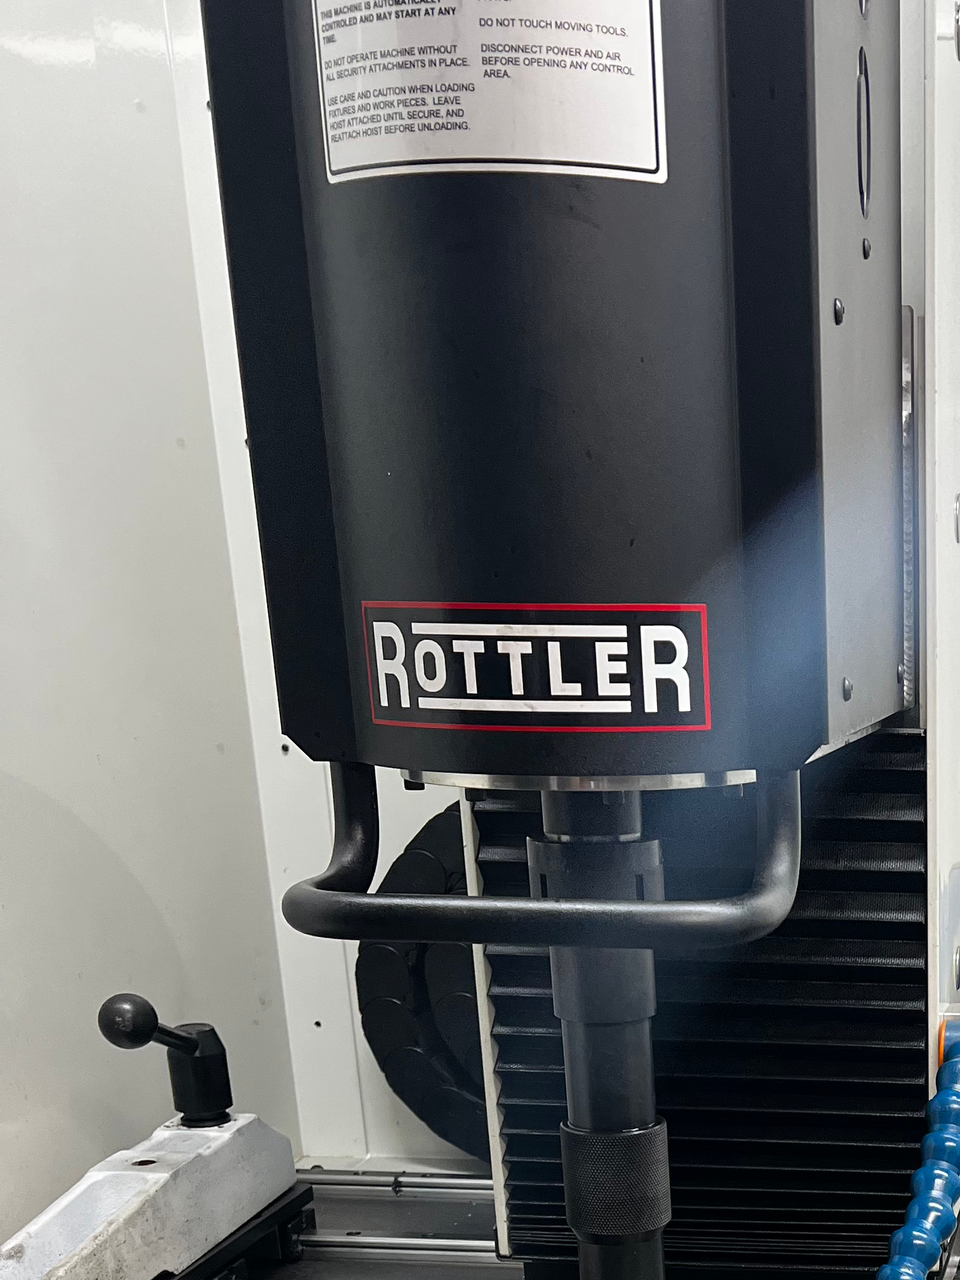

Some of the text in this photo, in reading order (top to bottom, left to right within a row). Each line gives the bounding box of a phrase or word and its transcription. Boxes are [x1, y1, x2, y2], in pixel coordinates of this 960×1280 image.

[321, 11, 332, 20] THIS
[334, 3, 362, 17] MACHINE
[364, 1, 371, 10] IS
[322, 7, 456, 32] CONTROLED AND MAY START AT ANY
[479, 18, 628, 37] DO NOT TOUCH MOVING TOOLS.
[323, 35, 337, 44] TIME.
[325, 45, 457, 70] DO NOT OPERATE MACHINE WITHOUT
[481, 43, 621, 61] DISCONNECT POWER AND AIR
[326, 58, 470, 82] ALL SECURITY ATTACHMENTS IN PLACE.
[482, 57, 634, 76] BEFORE OPENING ANY CONTROL
[484, 69, 511, 78] AREA.
[328, 83, 475, 106] USE CARE AND CAUTION WHEN LOADING
[329, 96, 461, 119] FIXTURES AND WORK PIECES. LEAVE
[330, 109, 464, 131] HOIST ATTACHED UNTIL SECURE, AND
[331, 121, 471, 143] REATTACH HOIST BEFORE UNLOADING.
[373, 621, 691, 713] ROTTLER
